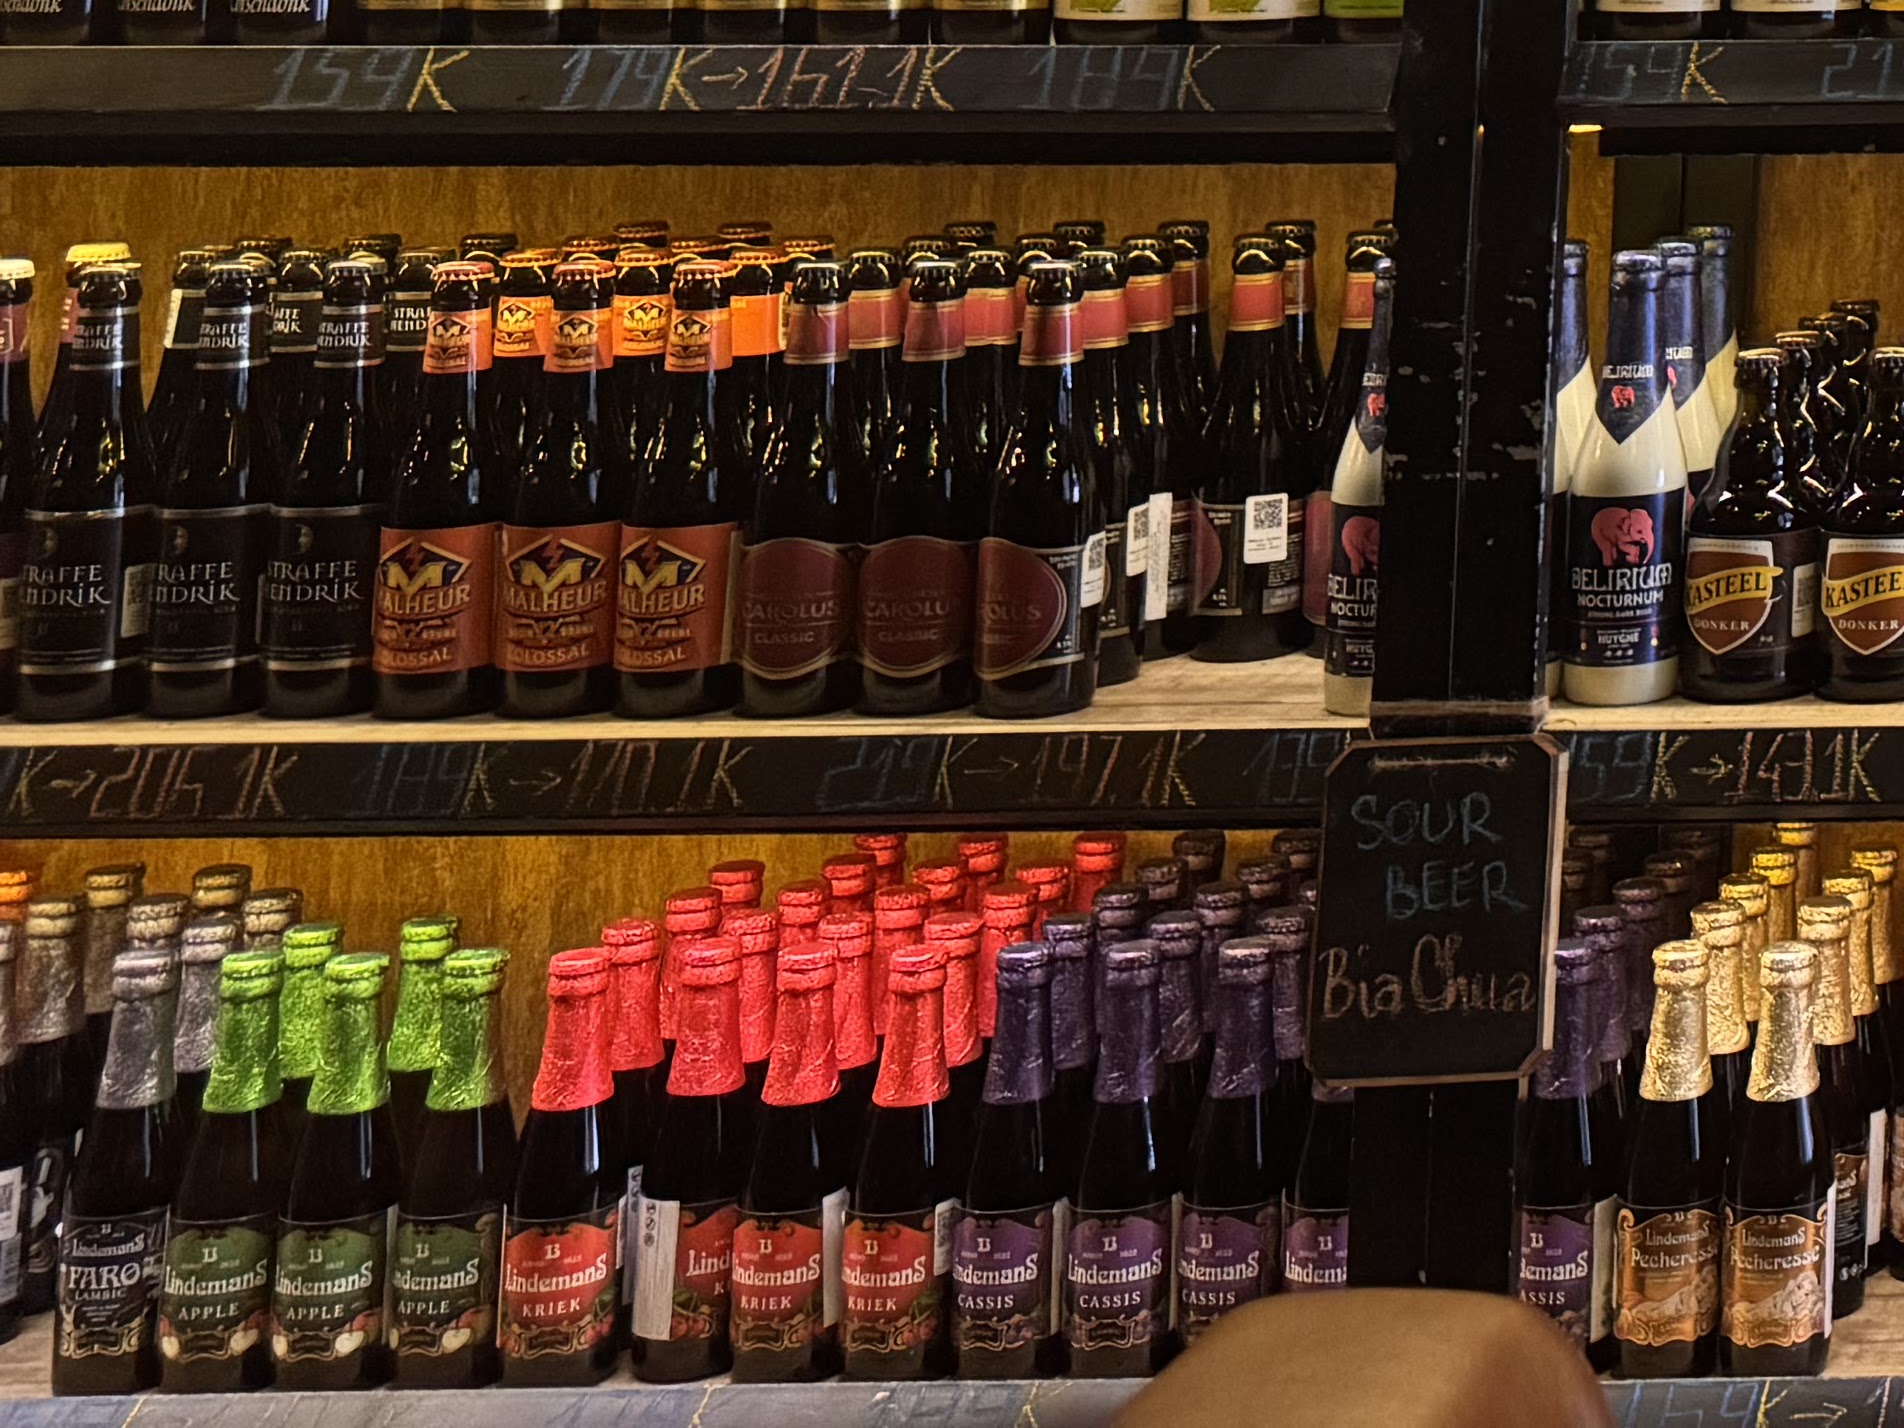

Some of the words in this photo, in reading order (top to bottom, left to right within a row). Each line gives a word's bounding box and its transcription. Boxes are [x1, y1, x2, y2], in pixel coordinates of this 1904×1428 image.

[1838, 618, 1900, 632] DONKER
[1351, 793, 1503, 851] SOUR
[1384, 860, 1529, 920] BEER
[522, 1299, 581, 1315] KRIEK
[1079, 1292, 1142, 1309] CASSIS
[178, 1304, 239, 1320] APPLE
